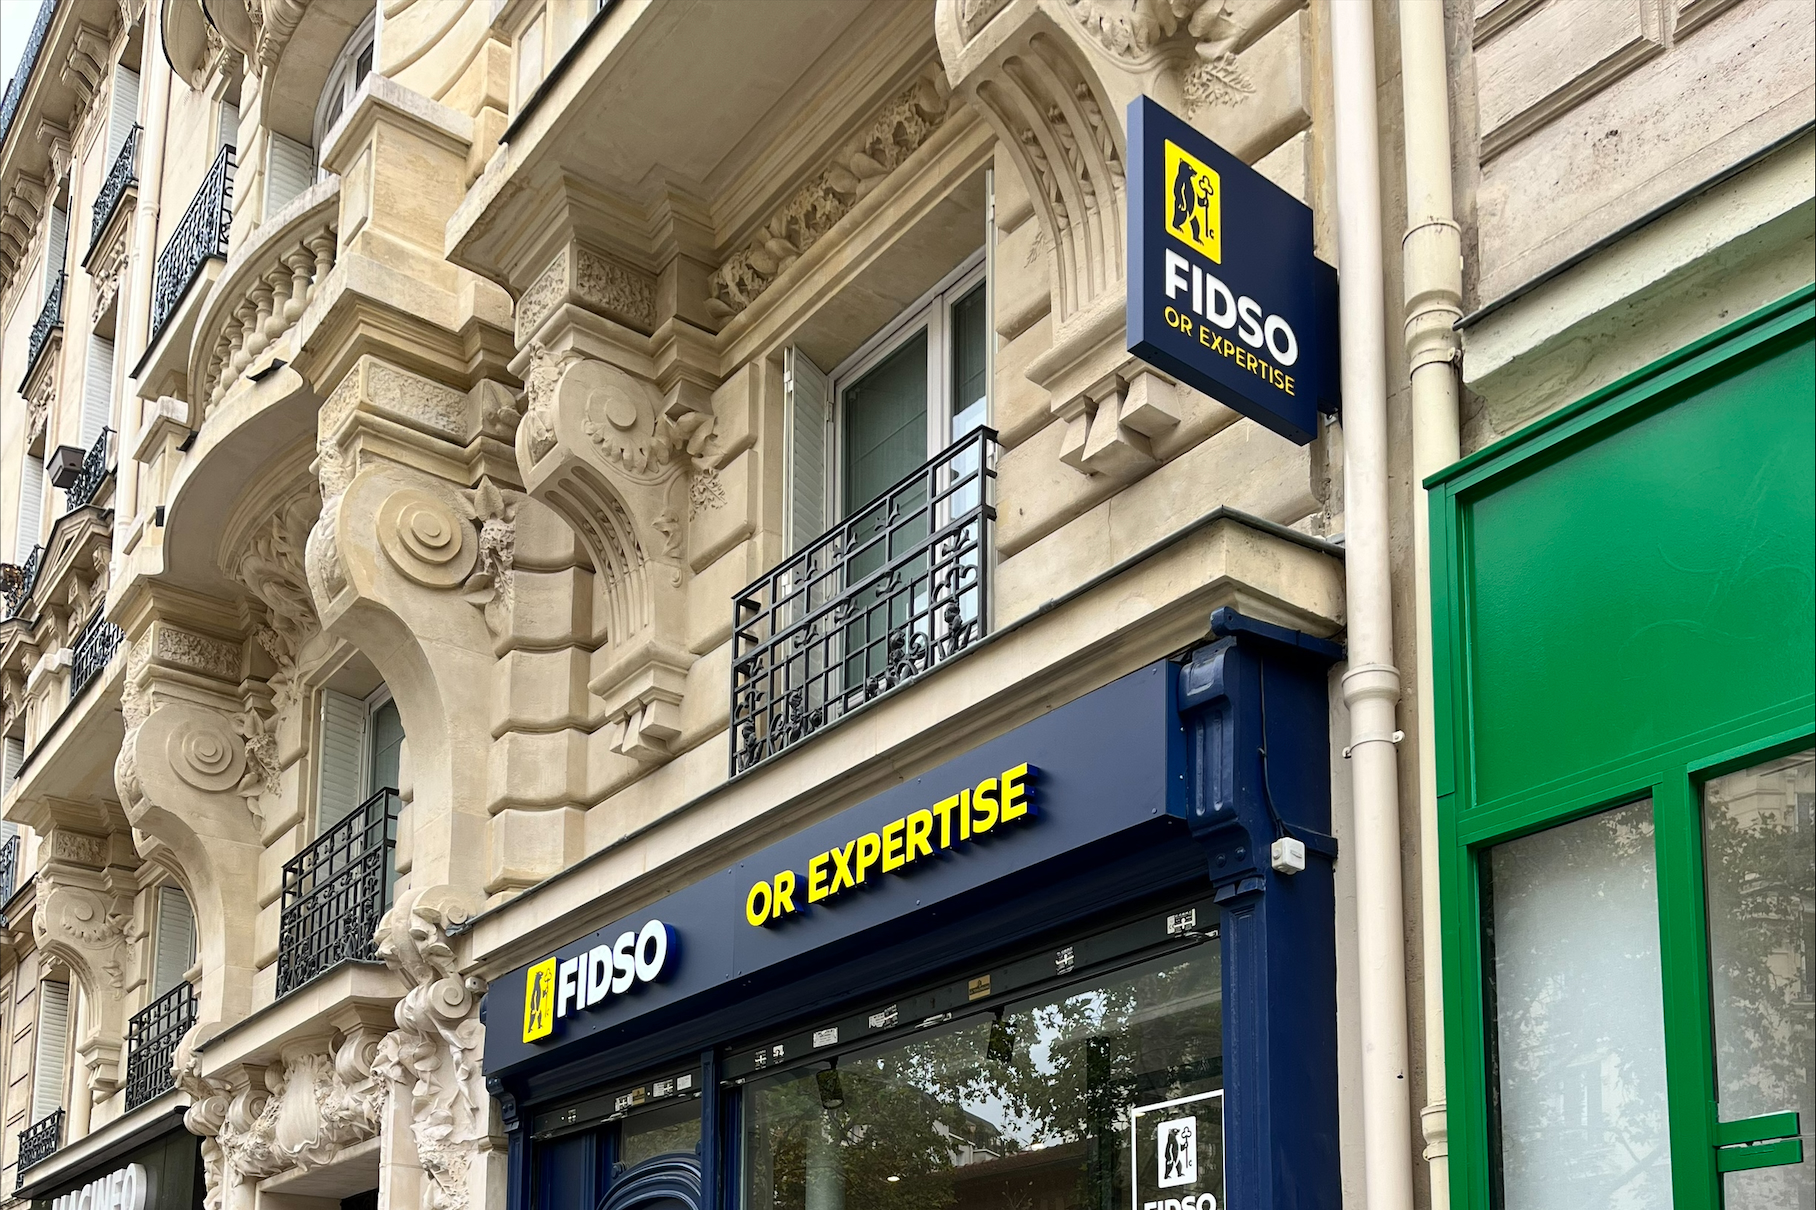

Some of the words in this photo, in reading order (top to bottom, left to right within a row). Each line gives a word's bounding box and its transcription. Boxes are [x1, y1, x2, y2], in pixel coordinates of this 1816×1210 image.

[1164, 305, 1193, 338] OR
[1199, 325, 1296, 397] EXPERTISE
[1165, 248, 1298, 367] FIDSO
[746, 869, 797, 928] OR
[808, 762, 1028, 904] EXPERTISE
[556, 918, 669, 1019] FIDSO
